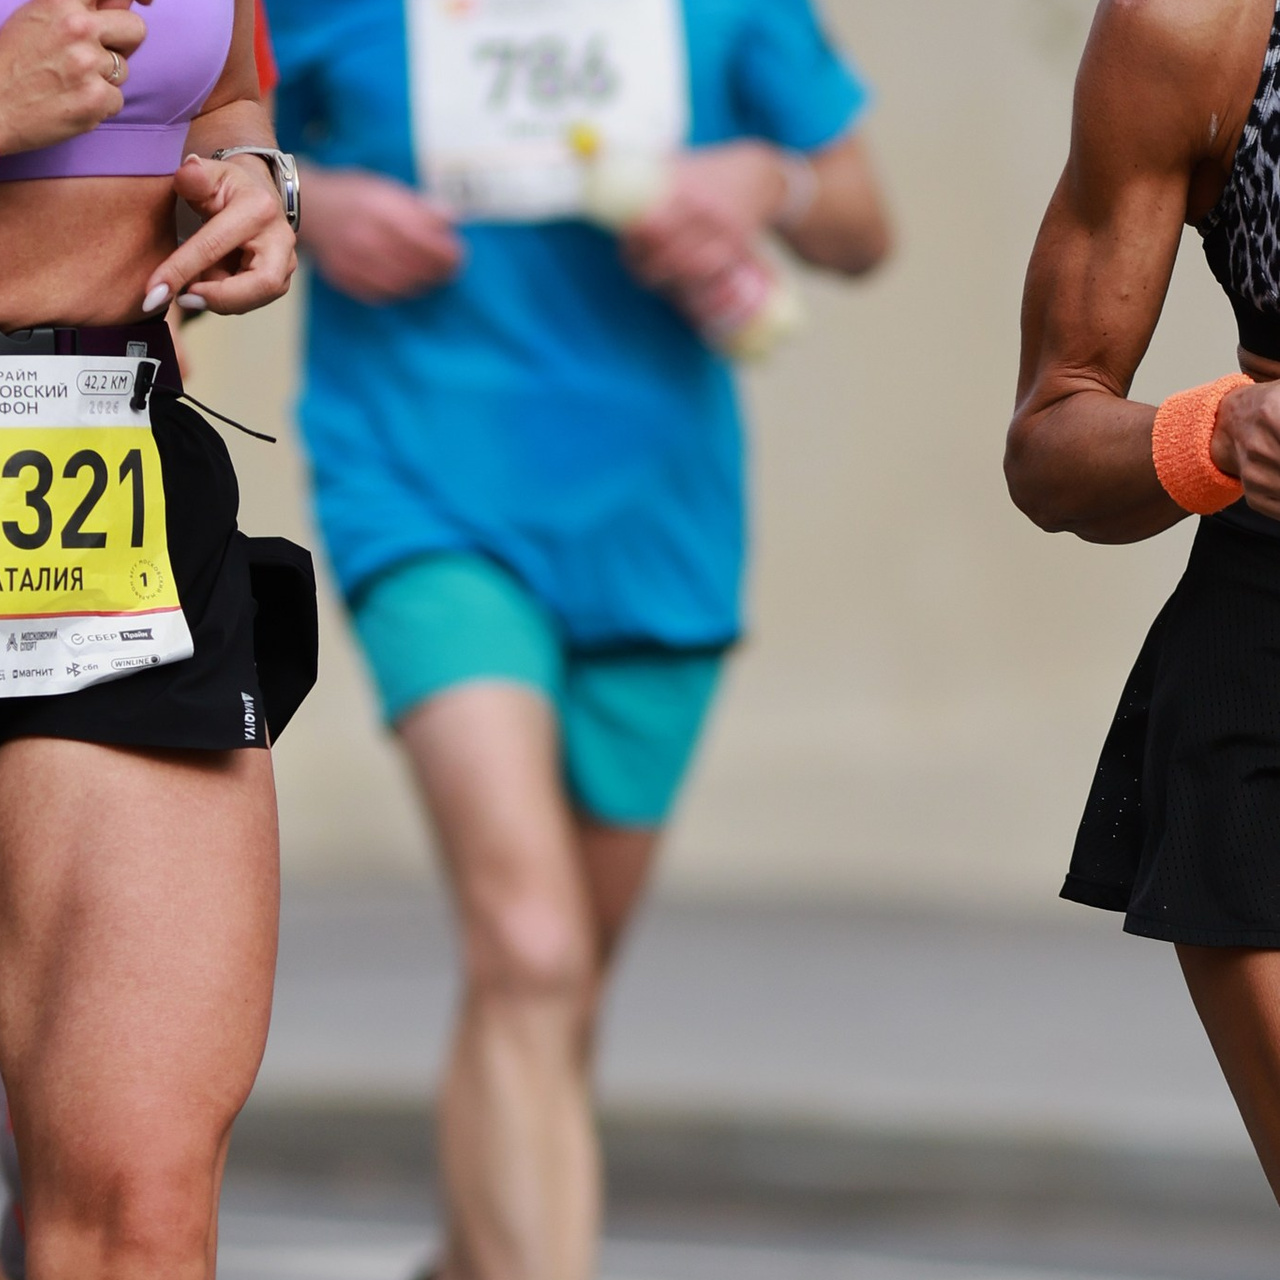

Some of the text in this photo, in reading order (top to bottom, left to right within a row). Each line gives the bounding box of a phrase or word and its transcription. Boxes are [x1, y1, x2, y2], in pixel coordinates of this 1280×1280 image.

[84, 375, 128, 391] 42,2 КМ
[139, 572, 148, 587] 1
[87, 632, 149, 642] СБЕР Прайм
[82, 663, 99, 671] сбп
[114, 658, 150, 668] WINLINE
[19, 668, 54, 678] магнит
